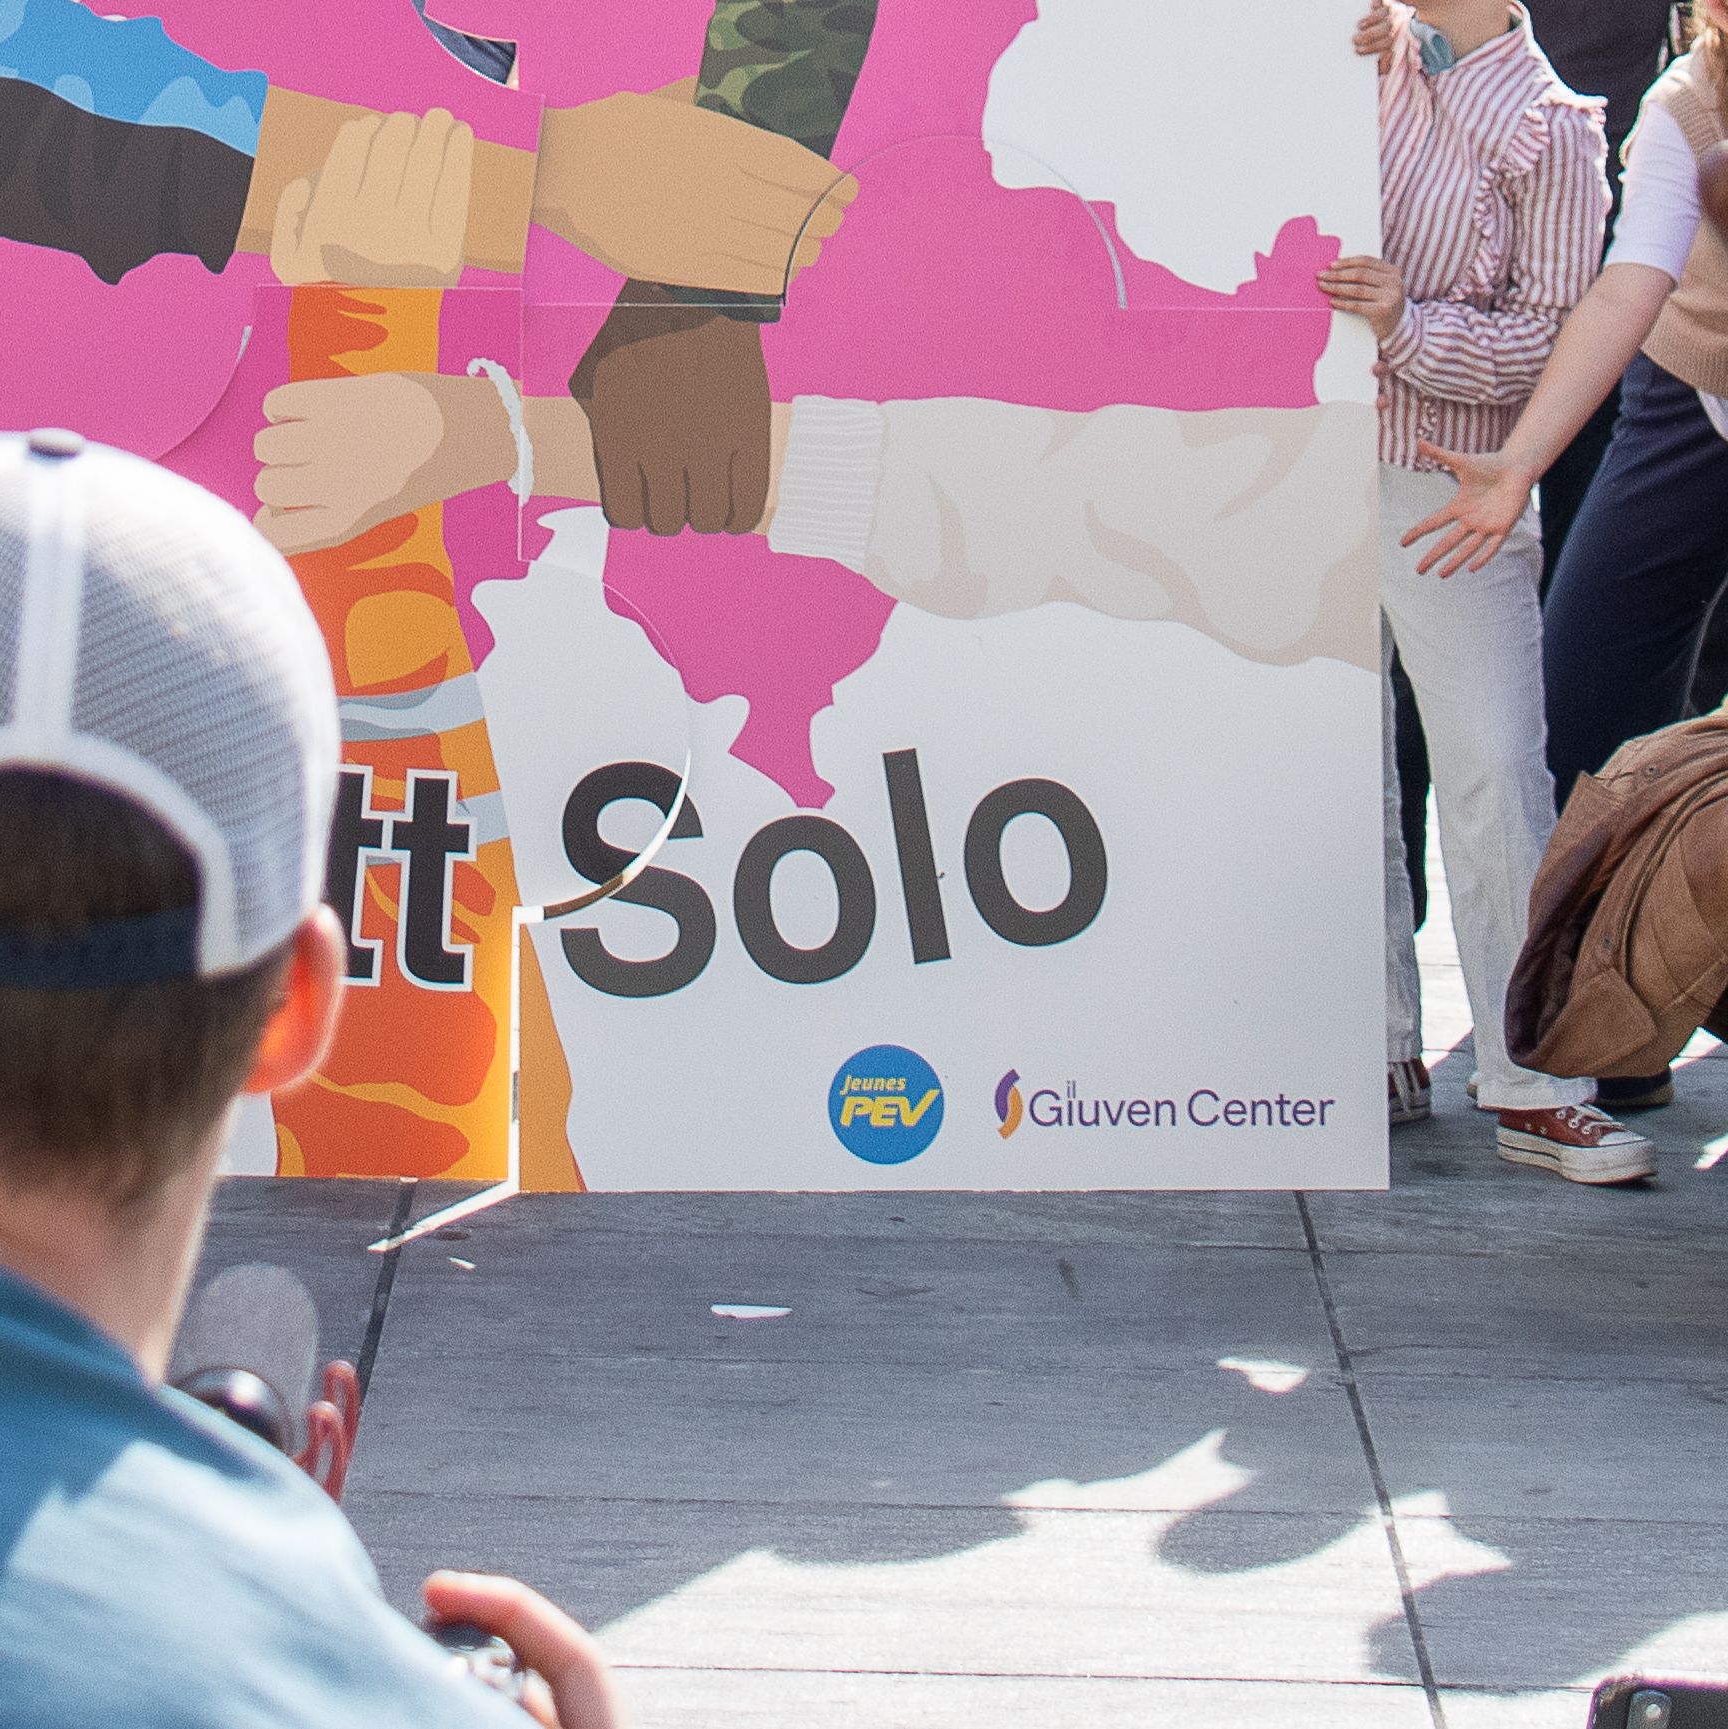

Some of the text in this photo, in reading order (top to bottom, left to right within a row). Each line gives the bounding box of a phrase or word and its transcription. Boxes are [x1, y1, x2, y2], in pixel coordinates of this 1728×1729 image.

[560, 747, 1109, 999] Solo
[839, 1088, 941, 1128] PEV
[1187, 1088, 1336, 1128] Center
